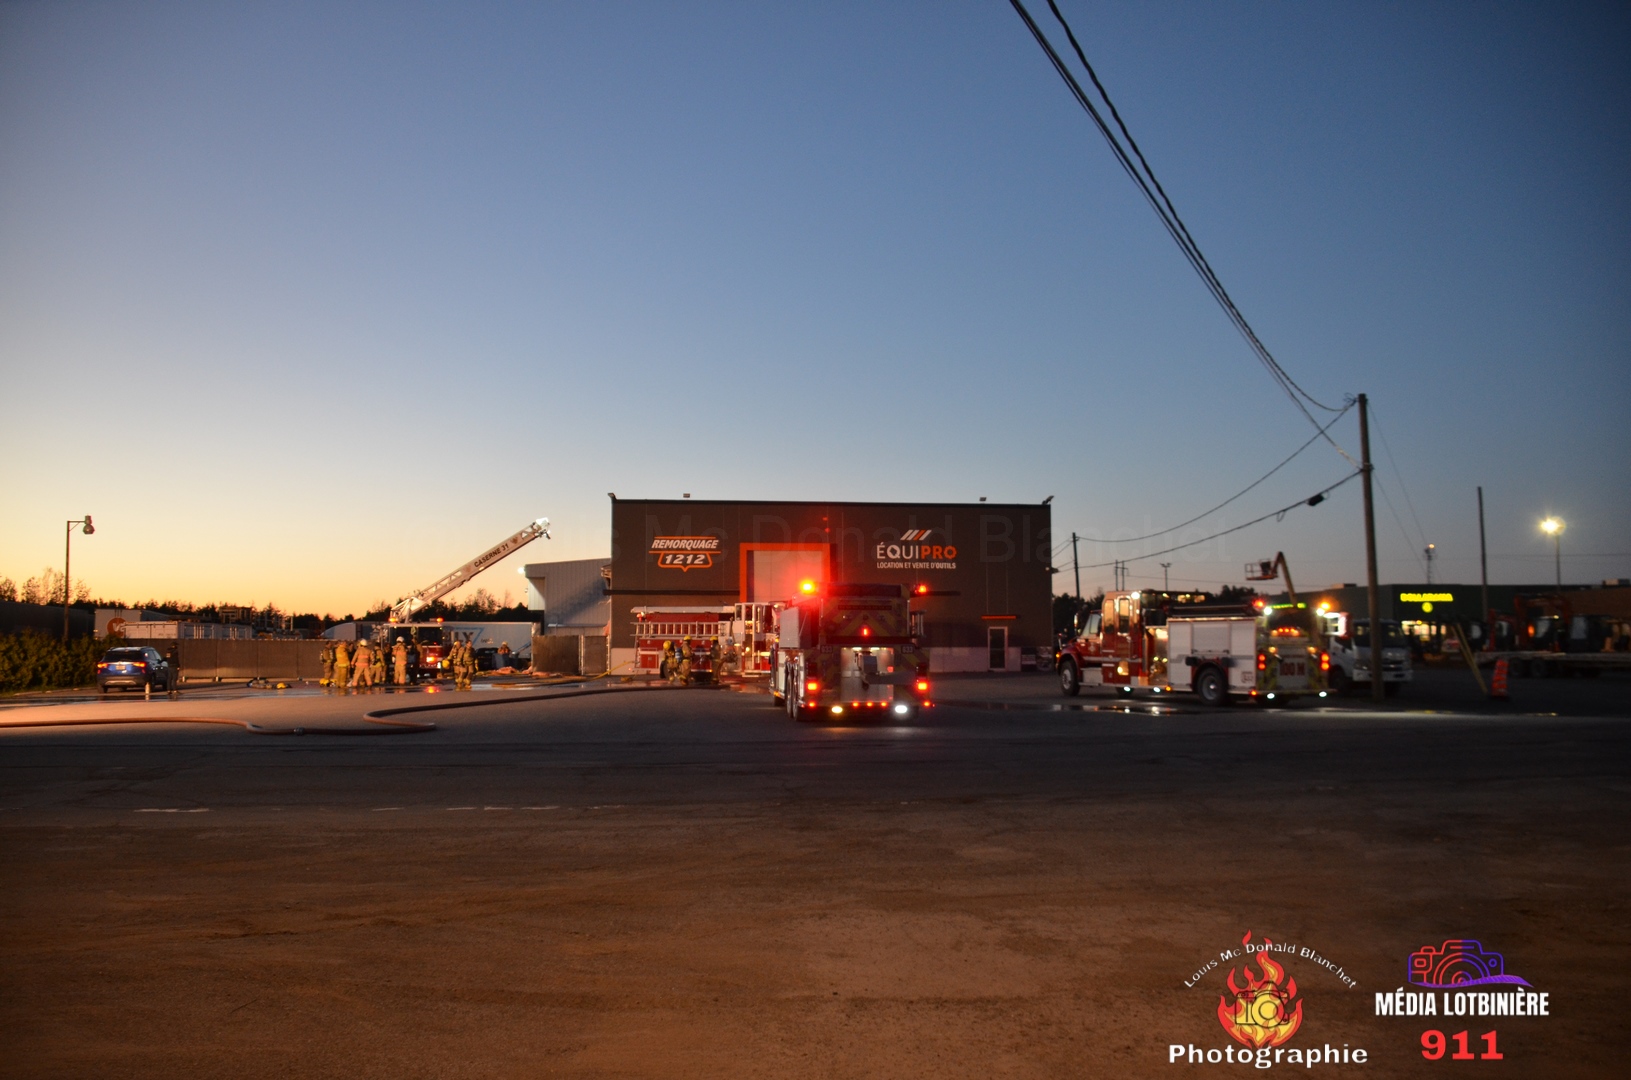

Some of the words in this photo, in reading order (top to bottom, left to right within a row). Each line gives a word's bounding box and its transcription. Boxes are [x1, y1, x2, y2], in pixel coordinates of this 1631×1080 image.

[651, 539, 719, 551] REMORQUAGE
[876, 542, 957, 560] ÉQUIPRO
[473, 547, 501, 568] CASERNE
[665, 554, 706, 564] 1212
[876, 561, 904, 569] LOCATION
[930, 561, 957, 569] D'OUTILS
